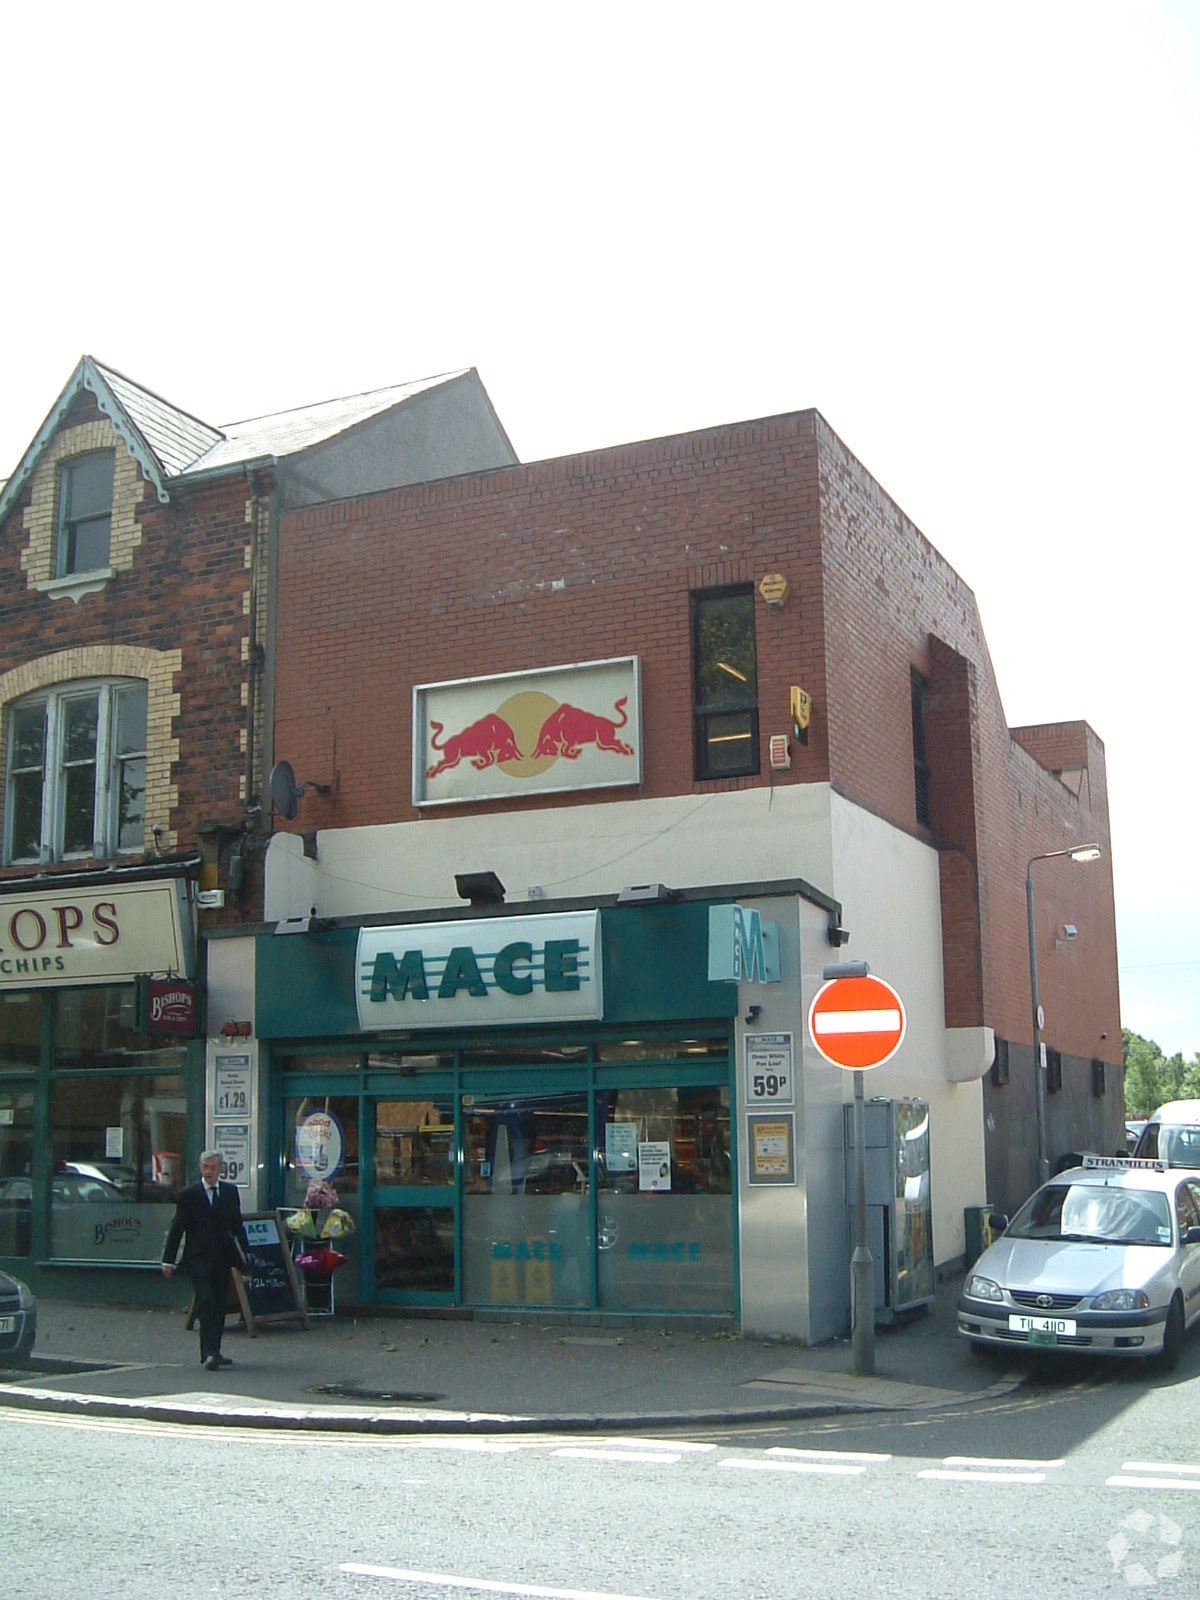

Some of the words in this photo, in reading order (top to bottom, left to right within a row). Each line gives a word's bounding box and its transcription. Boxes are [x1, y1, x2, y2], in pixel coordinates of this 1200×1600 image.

[0, 902, 120, 952] OPS
[0, 955, 65, 974] CHIPS
[370, 938, 582, 1003] MACE
[220, 1091, 246, 1109] £1.29
[1086, 1157, 1164, 1170] STRANMILLIS
[247, 1223, 269, 1235] ACE
